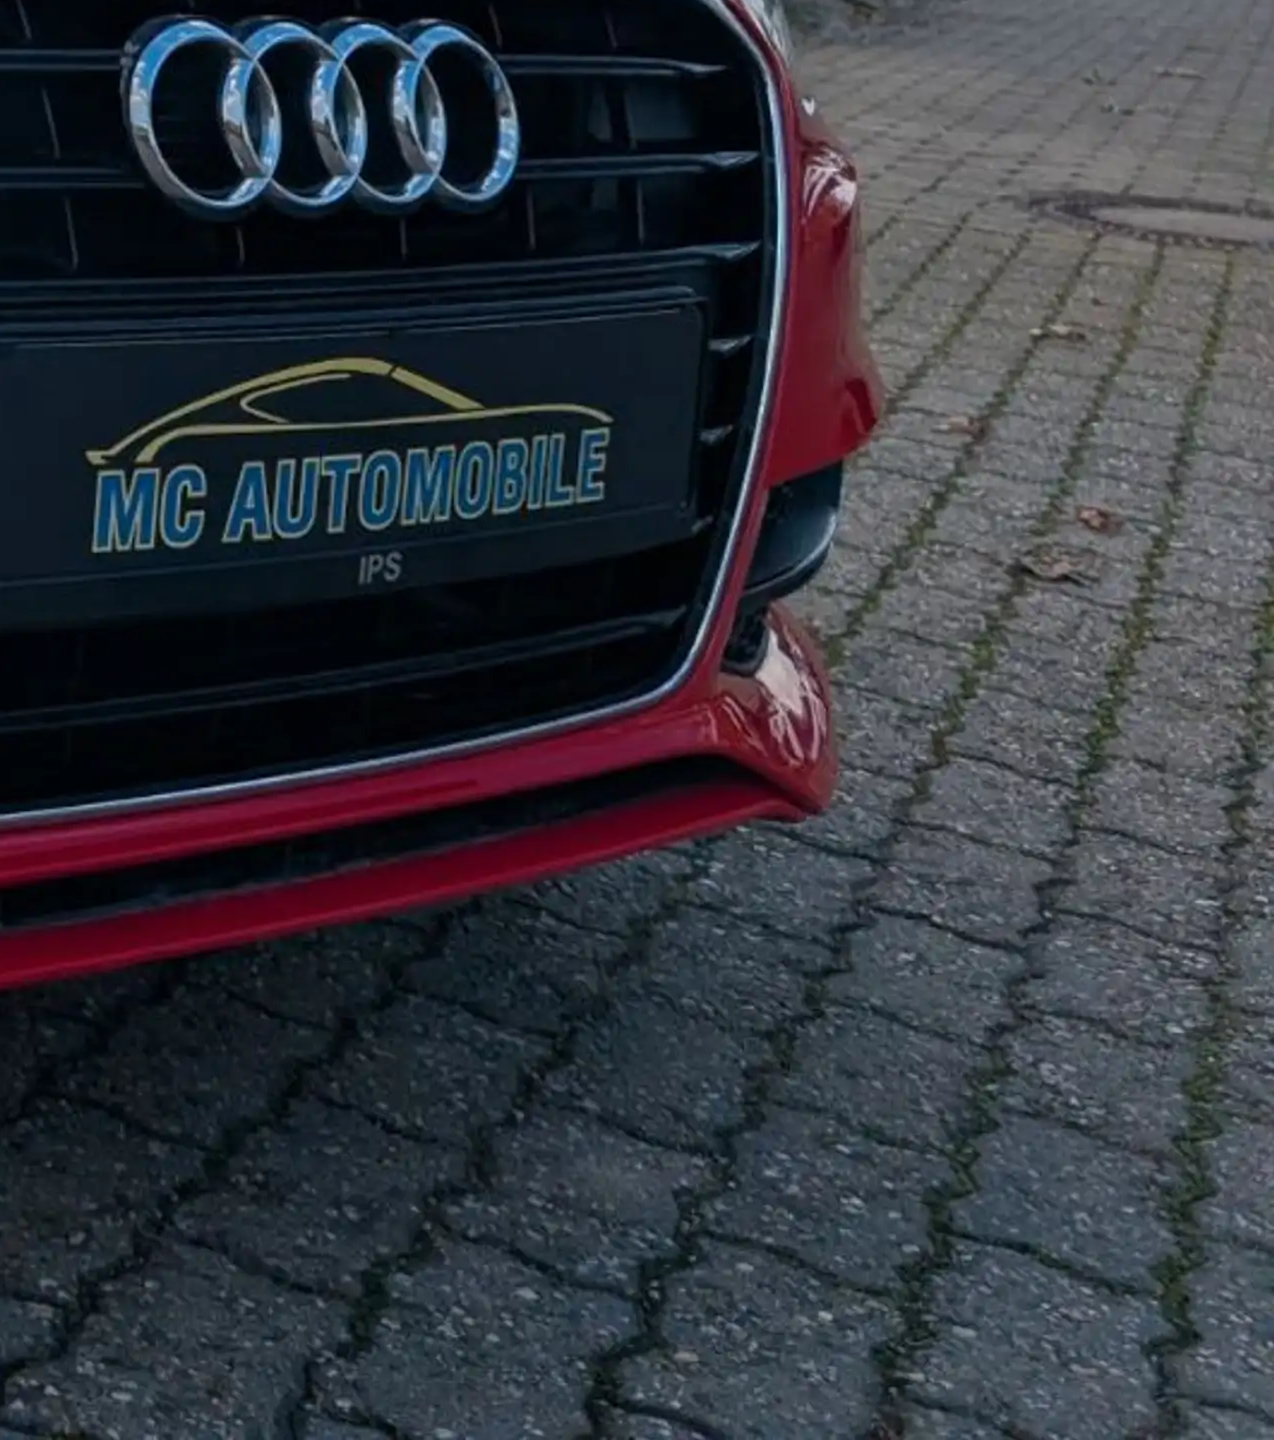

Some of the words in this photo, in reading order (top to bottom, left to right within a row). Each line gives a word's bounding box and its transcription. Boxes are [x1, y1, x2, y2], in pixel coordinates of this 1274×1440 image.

[91, 464, 208, 553] MC
[221, 427, 611, 543] AUTOMOBILE
[358, 551, 403, 586] IPS
